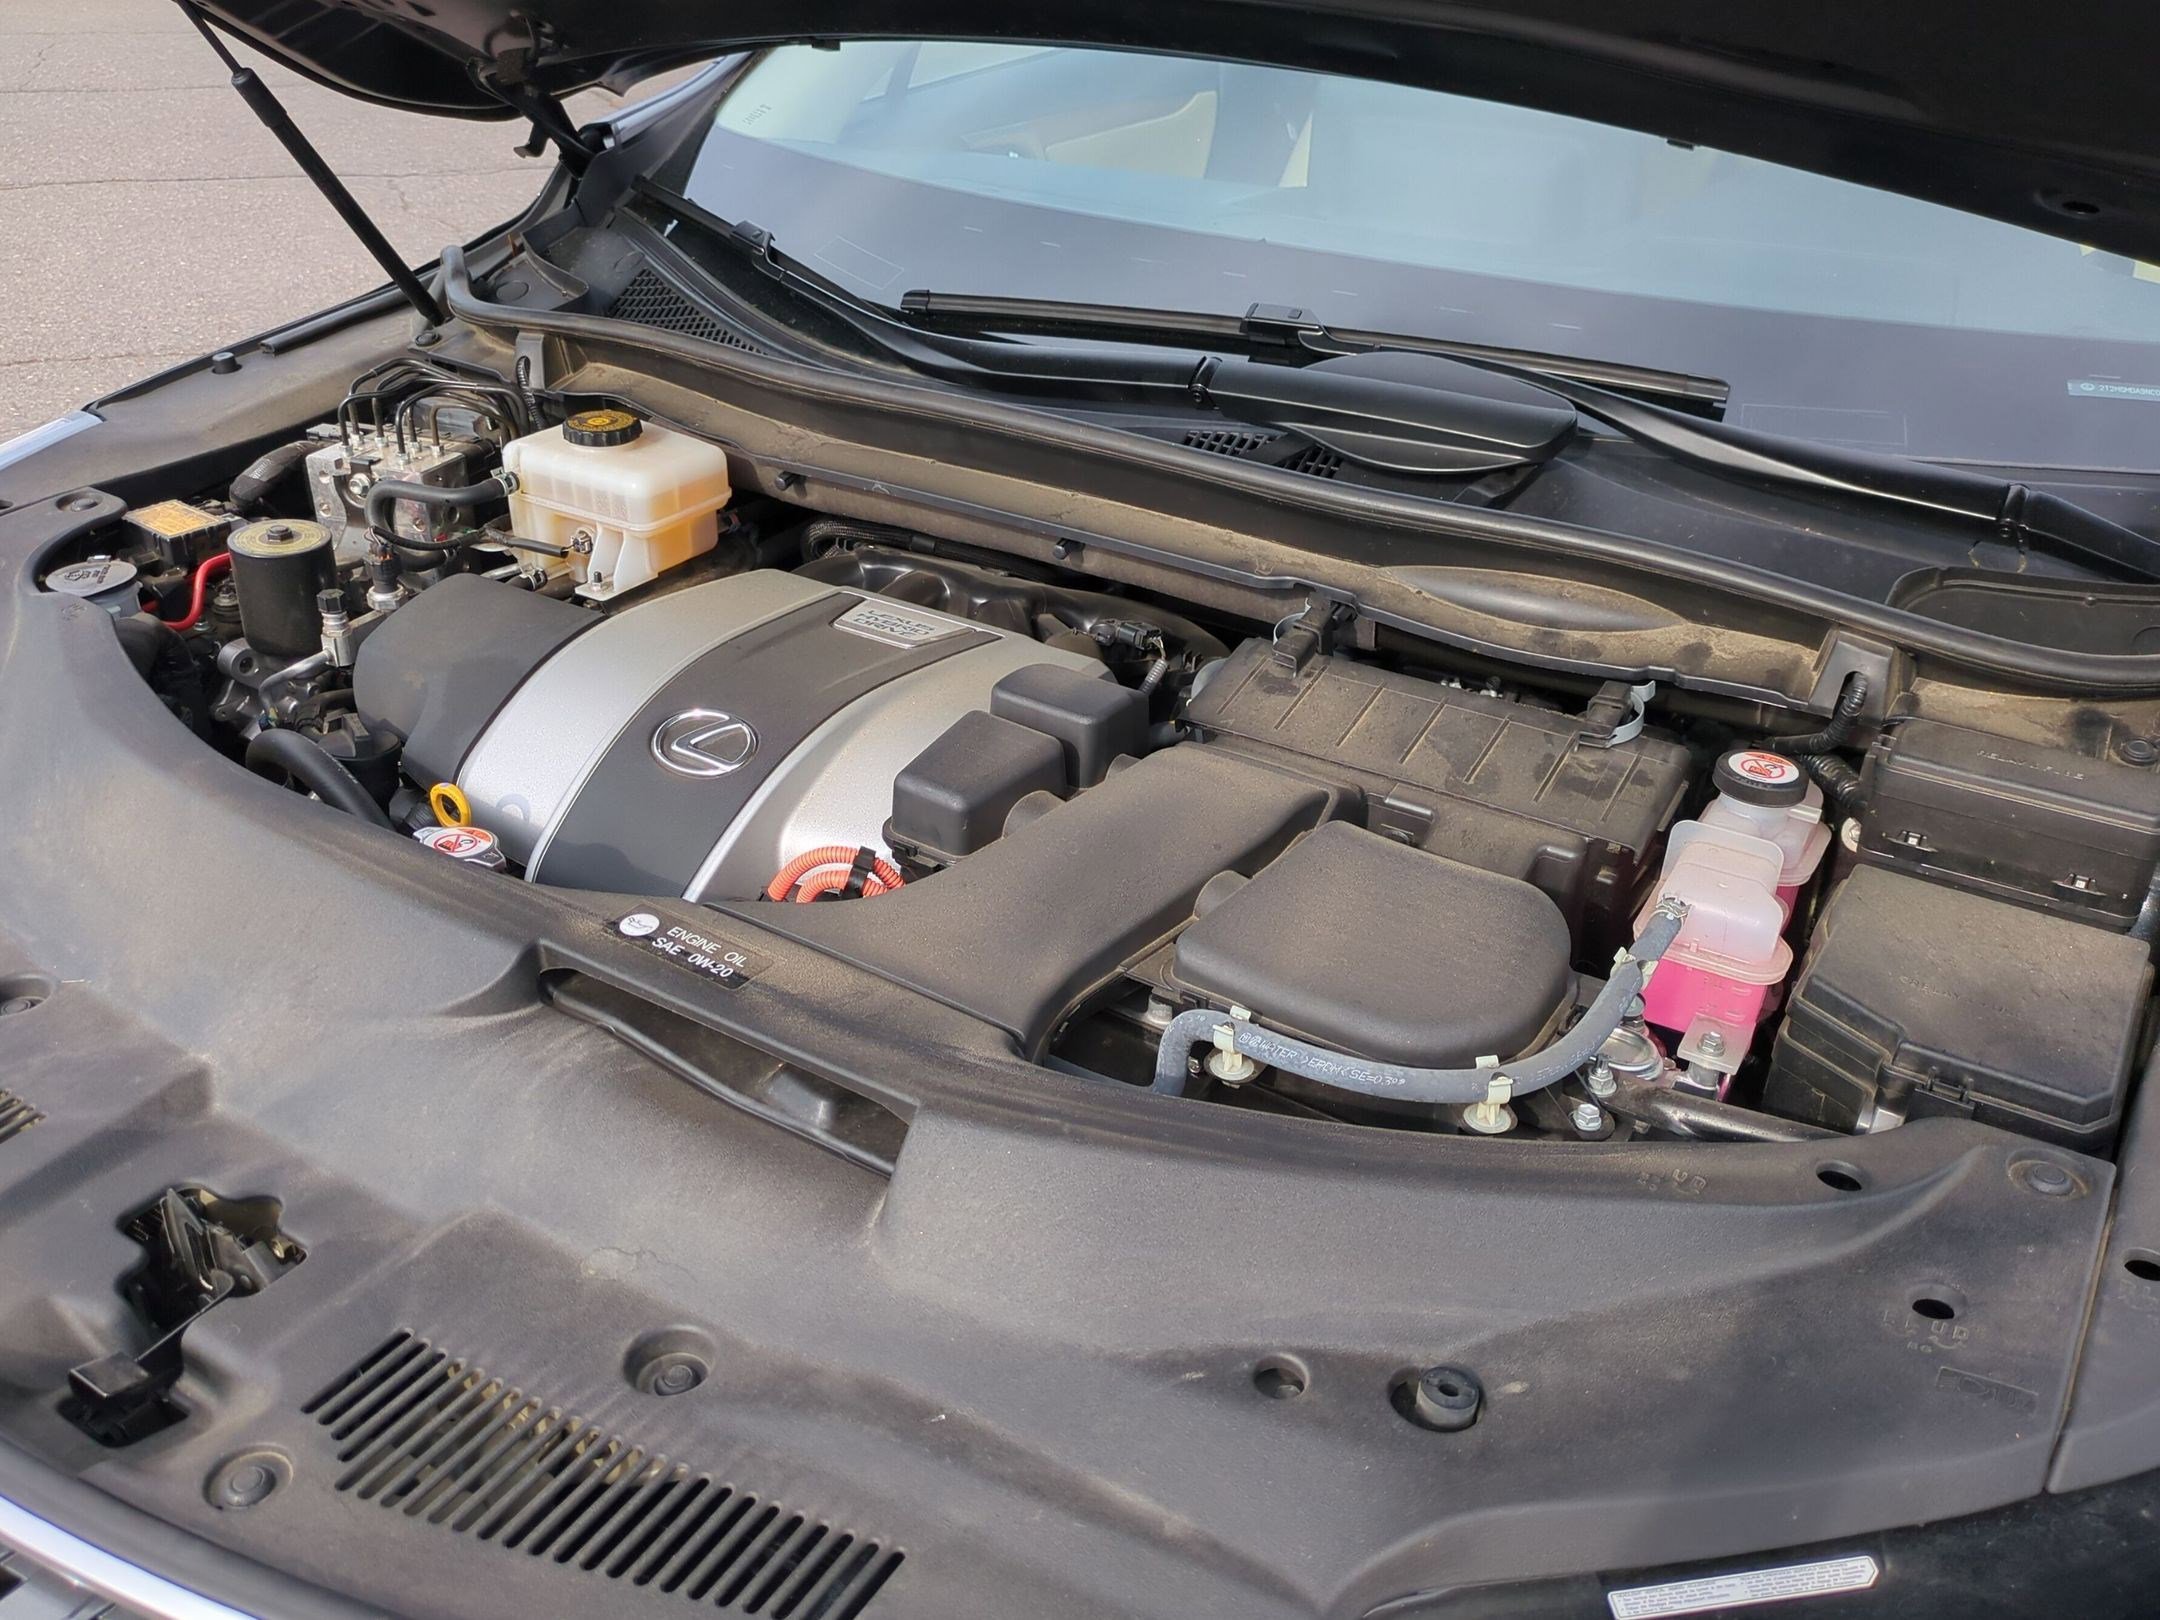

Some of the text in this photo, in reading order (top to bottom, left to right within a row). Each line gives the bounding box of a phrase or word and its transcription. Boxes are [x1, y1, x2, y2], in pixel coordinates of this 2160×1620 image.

[853, 618, 917, 636] DRIVE
[857, 613, 930, 635] HYBRID
[868, 609, 935, 631] LEXUS
[652, 937, 734, 978] SAE 0W-20
[667, 926, 749, 968] ENGINE OIL
[1259, 1038, 1298, 1060] WATER
